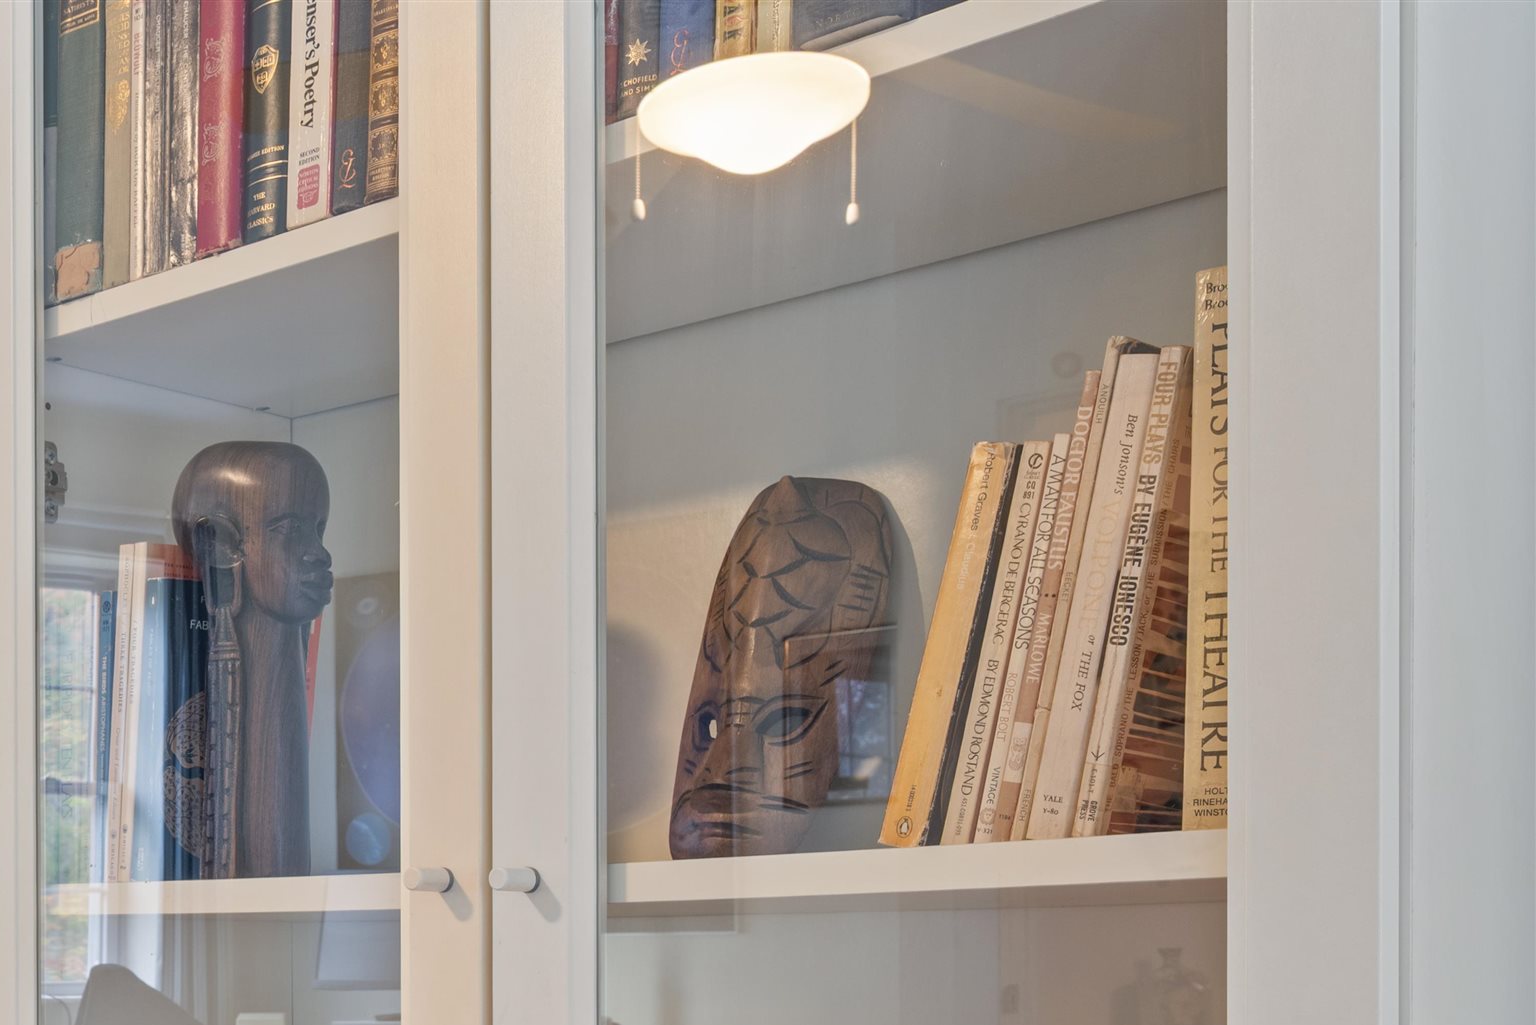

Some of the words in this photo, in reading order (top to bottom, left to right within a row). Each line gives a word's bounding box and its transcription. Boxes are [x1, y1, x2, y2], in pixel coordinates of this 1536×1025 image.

[301, 60, 320, 128] Poetry
[298, 155, 320, 166] EDITION
[299, 147, 320, 158] SECOND
[247, 216, 274, 229] CLASSICS
[1156, 361, 1178, 406] FOUR
[1063, 404, 1093, 486] DOCTOR
[1125, 413, 1138, 441] Ben
[1143, 408, 1169, 466] PLAYS
[981, 450, 996, 490] Robert
[1113, 440, 1136, 496] Jonson's
[1137, 474, 1157, 496] BY
[1041, 468, 1064, 508] MAN
[970, 490, 988, 531] Graves
[1038, 511, 1056, 542] FOR
[1010, 502, 1032, 560] CYRANO
[1030, 546, 1048, 574] ALL
[992, 580, 1016, 646] BERGERAC
[1015, 574, 1042, 650] SEASONS
[1110, 575, 1138, 647] IONESCO
[1025, 612, 1053, 684] MARLOWE
[1079, 650, 1093, 680] THE
[986, 658, 1000, 679] BY
[973, 678, 996, 735] EDMOND
[1002, 672, 1018, 714] ROBERT
[1070, 681, 1087, 712] FOX
[996, 716, 1011, 743] BOLT
[960, 736, 984, 796] ROSTAND
[986, 766, 1001, 805] VINTAGE
[1018, 788, 1033, 823] FRENCH
[1043, 793, 1064, 805] YALE
[1079, 800, 1089, 821] PRESS
[1090, 801, 1098, 823] GROVE
